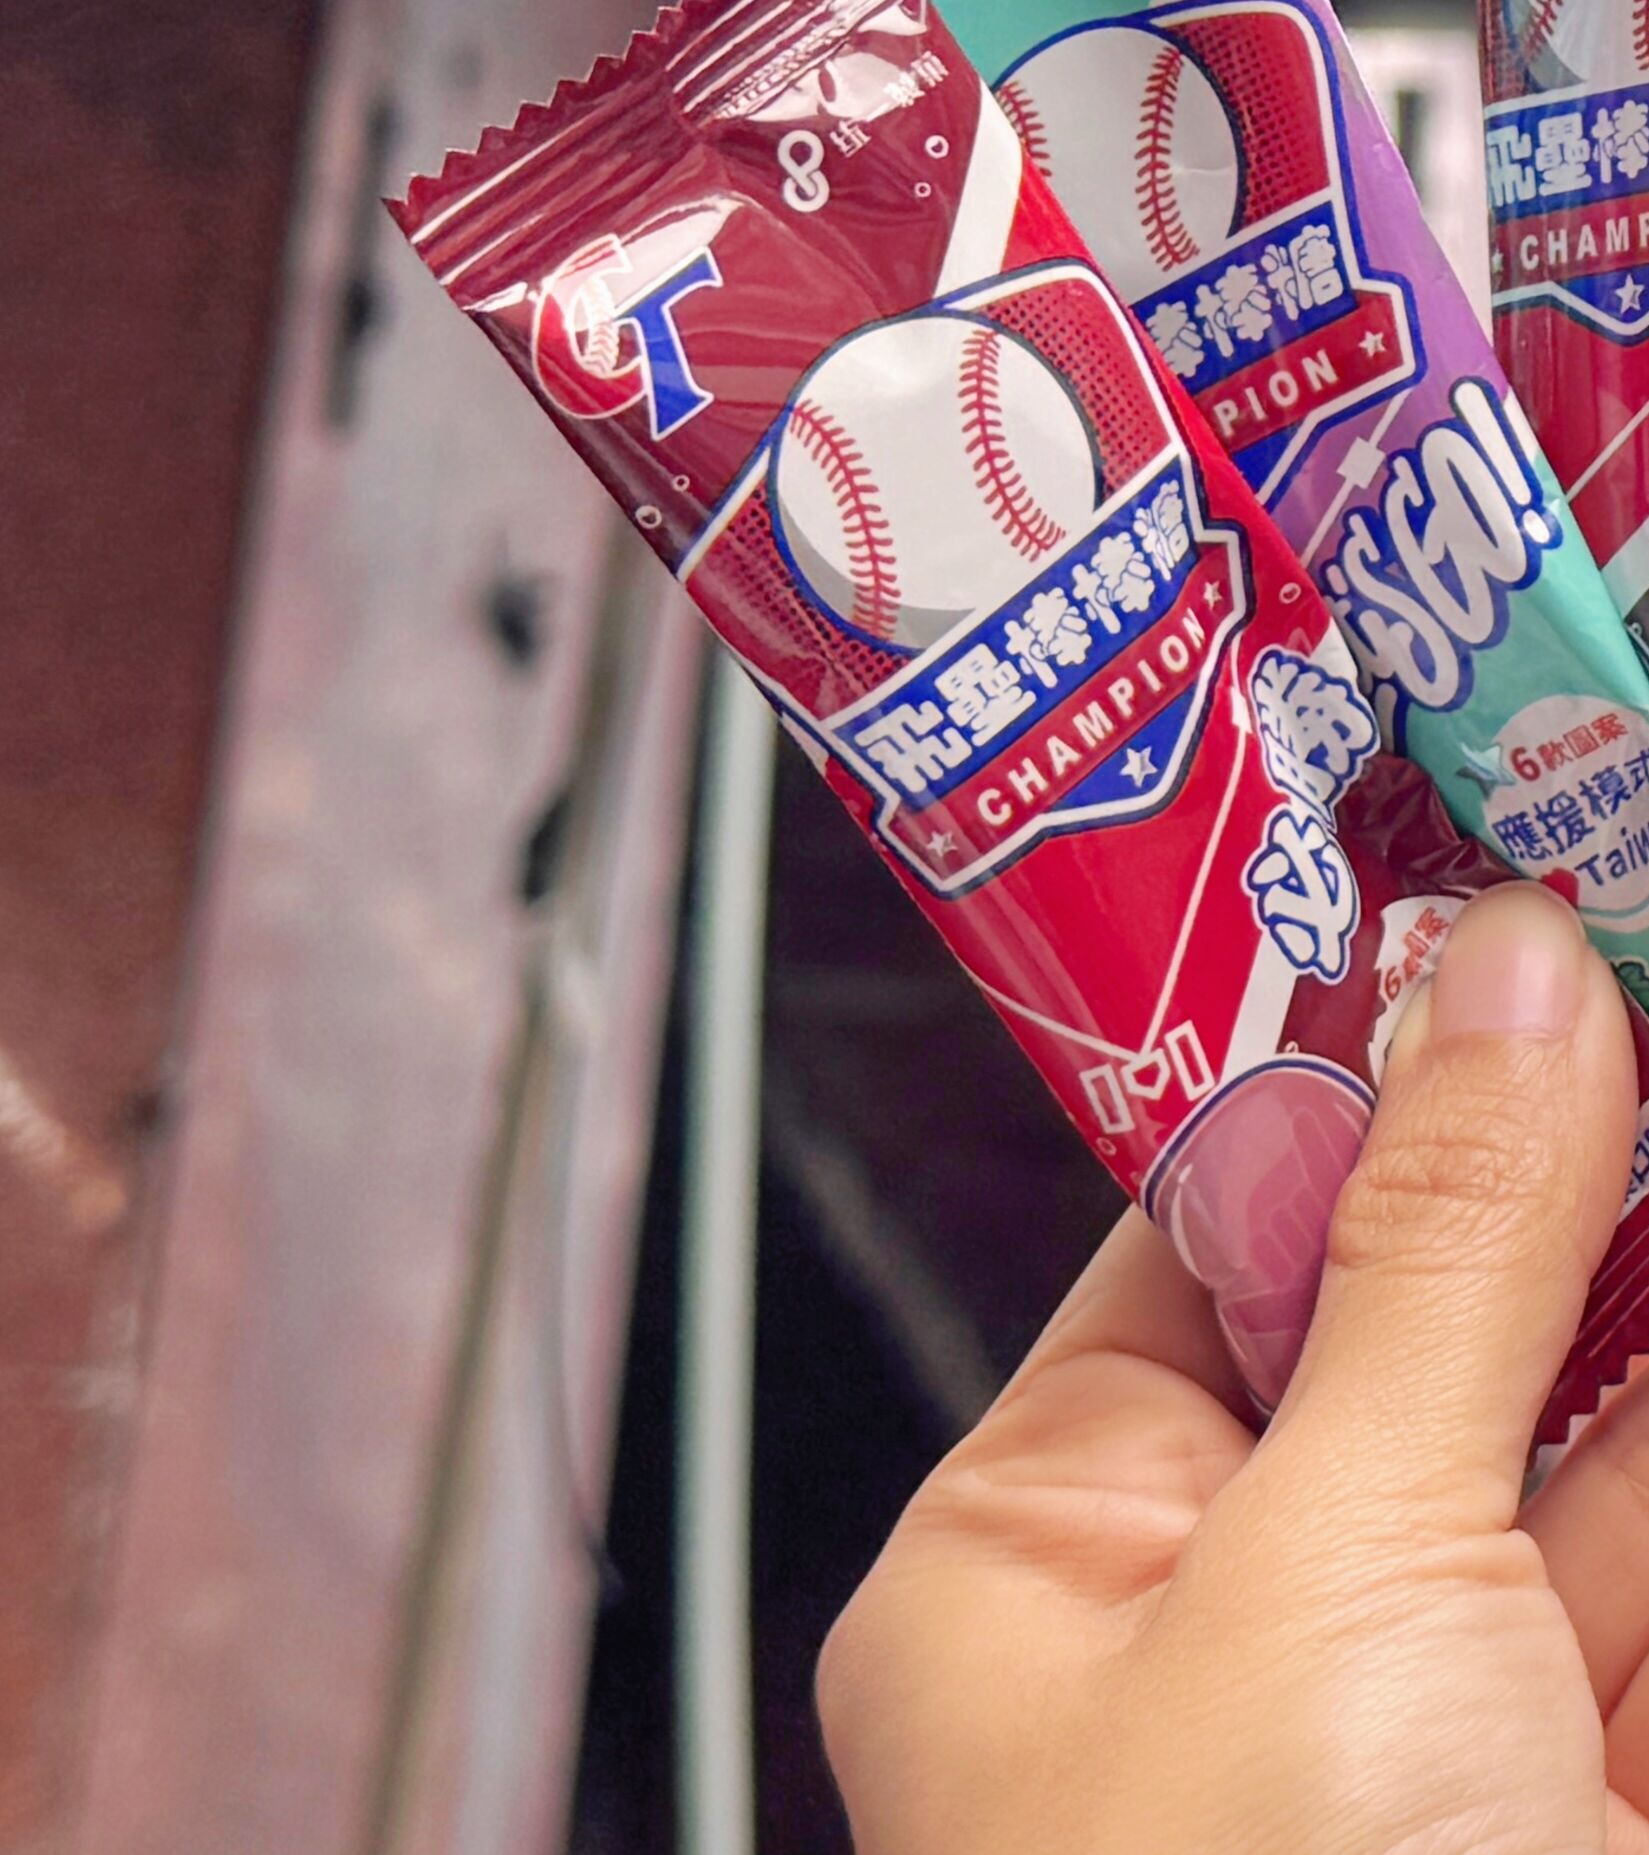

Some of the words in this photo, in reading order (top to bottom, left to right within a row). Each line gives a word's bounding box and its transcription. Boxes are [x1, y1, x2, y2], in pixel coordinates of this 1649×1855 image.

[854, 479, 1191, 794] 飛壘棒棒糖
[976, 604, 1208, 828] CHAMPION
[1509, 712, 1629, 782] 6款圖案
[1243, 644, 1381, 986] 必勝
